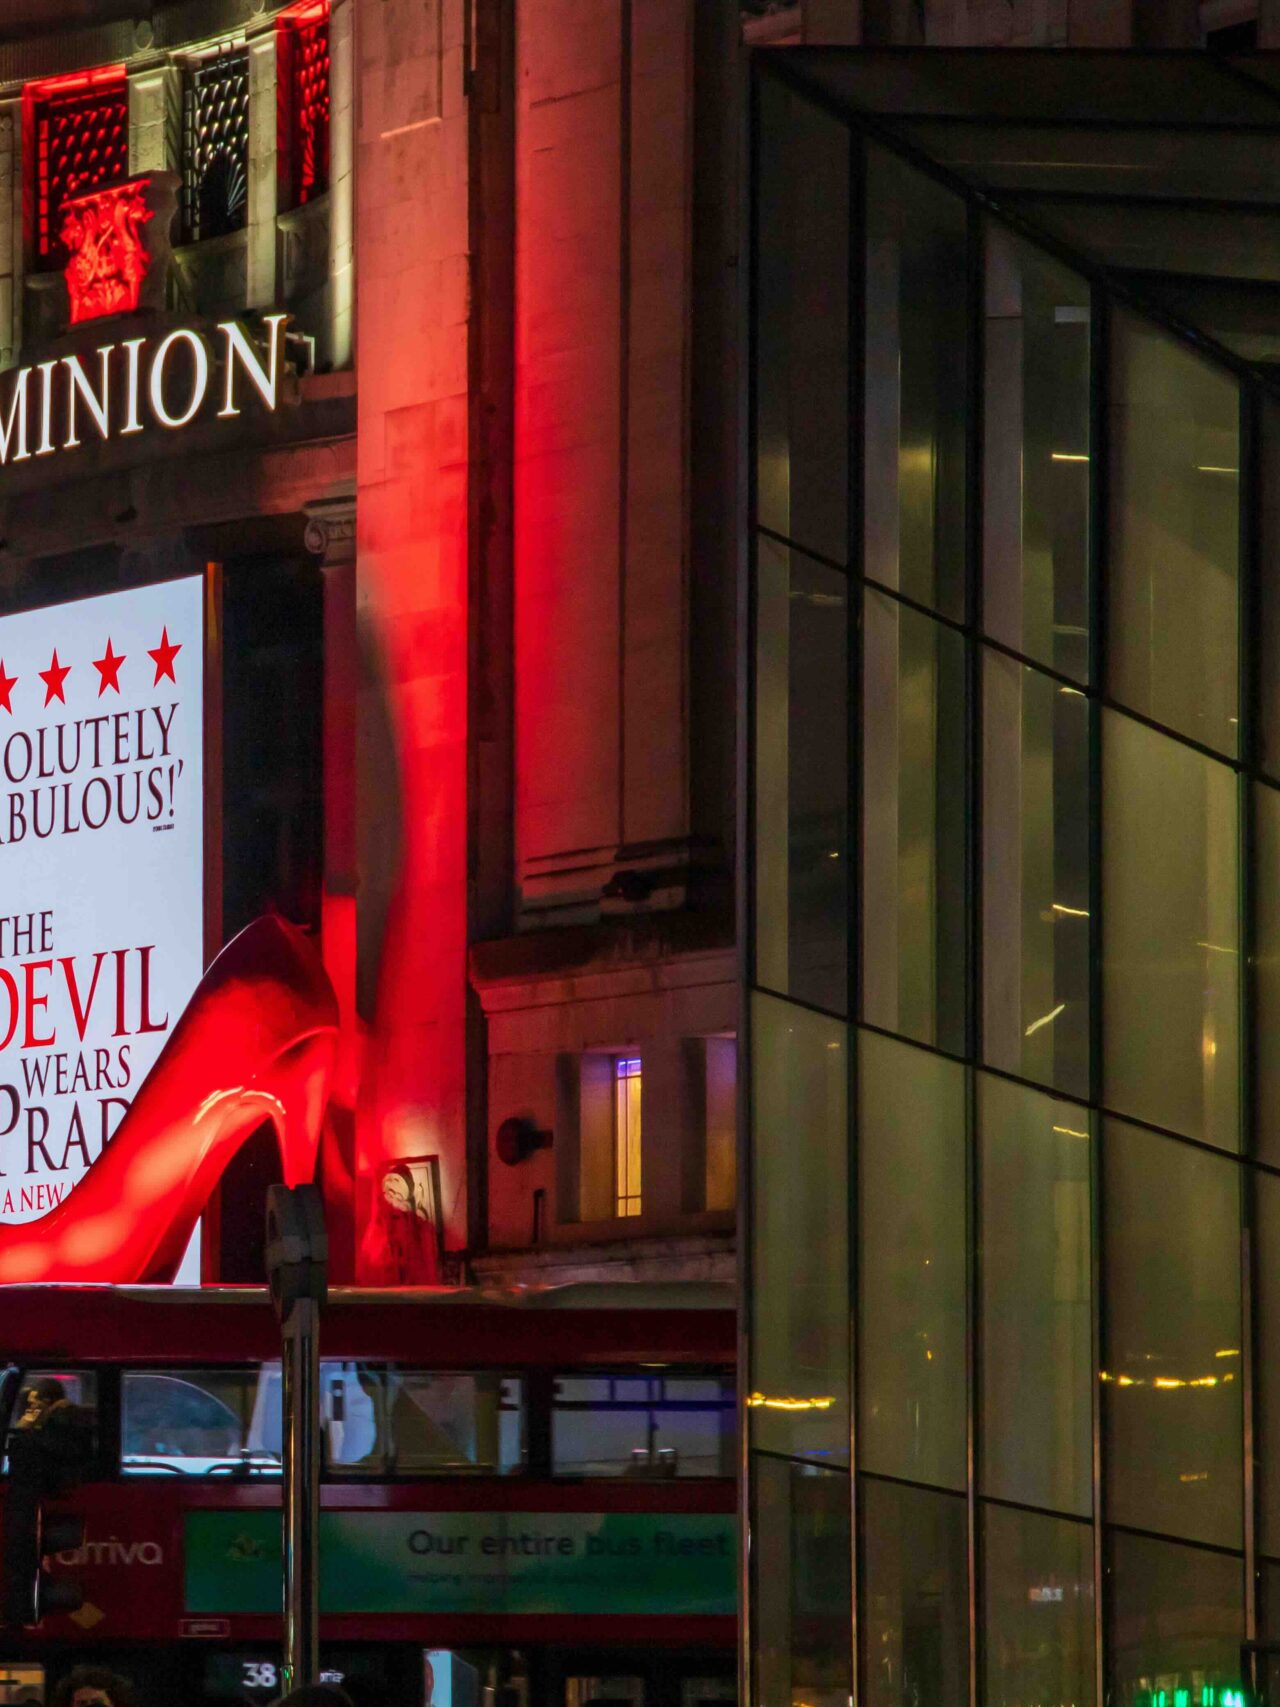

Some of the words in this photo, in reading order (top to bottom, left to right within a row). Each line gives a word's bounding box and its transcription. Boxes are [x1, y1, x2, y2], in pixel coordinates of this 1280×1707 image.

[20, 1045, 132, 1099] WEARS
[1, 1188, 16, 1214] A
[20, 1183, 65, 1212] NEW
[54, 1535, 164, 1566] arriva
[408, 1530, 469, 1556] Our
[481, 1532, 574, 1556] entire
[586, 1531, 640, 1556] bus
[655, 1531, 730, 1557] fleet
[240, 1661, 278, 1688] 38
